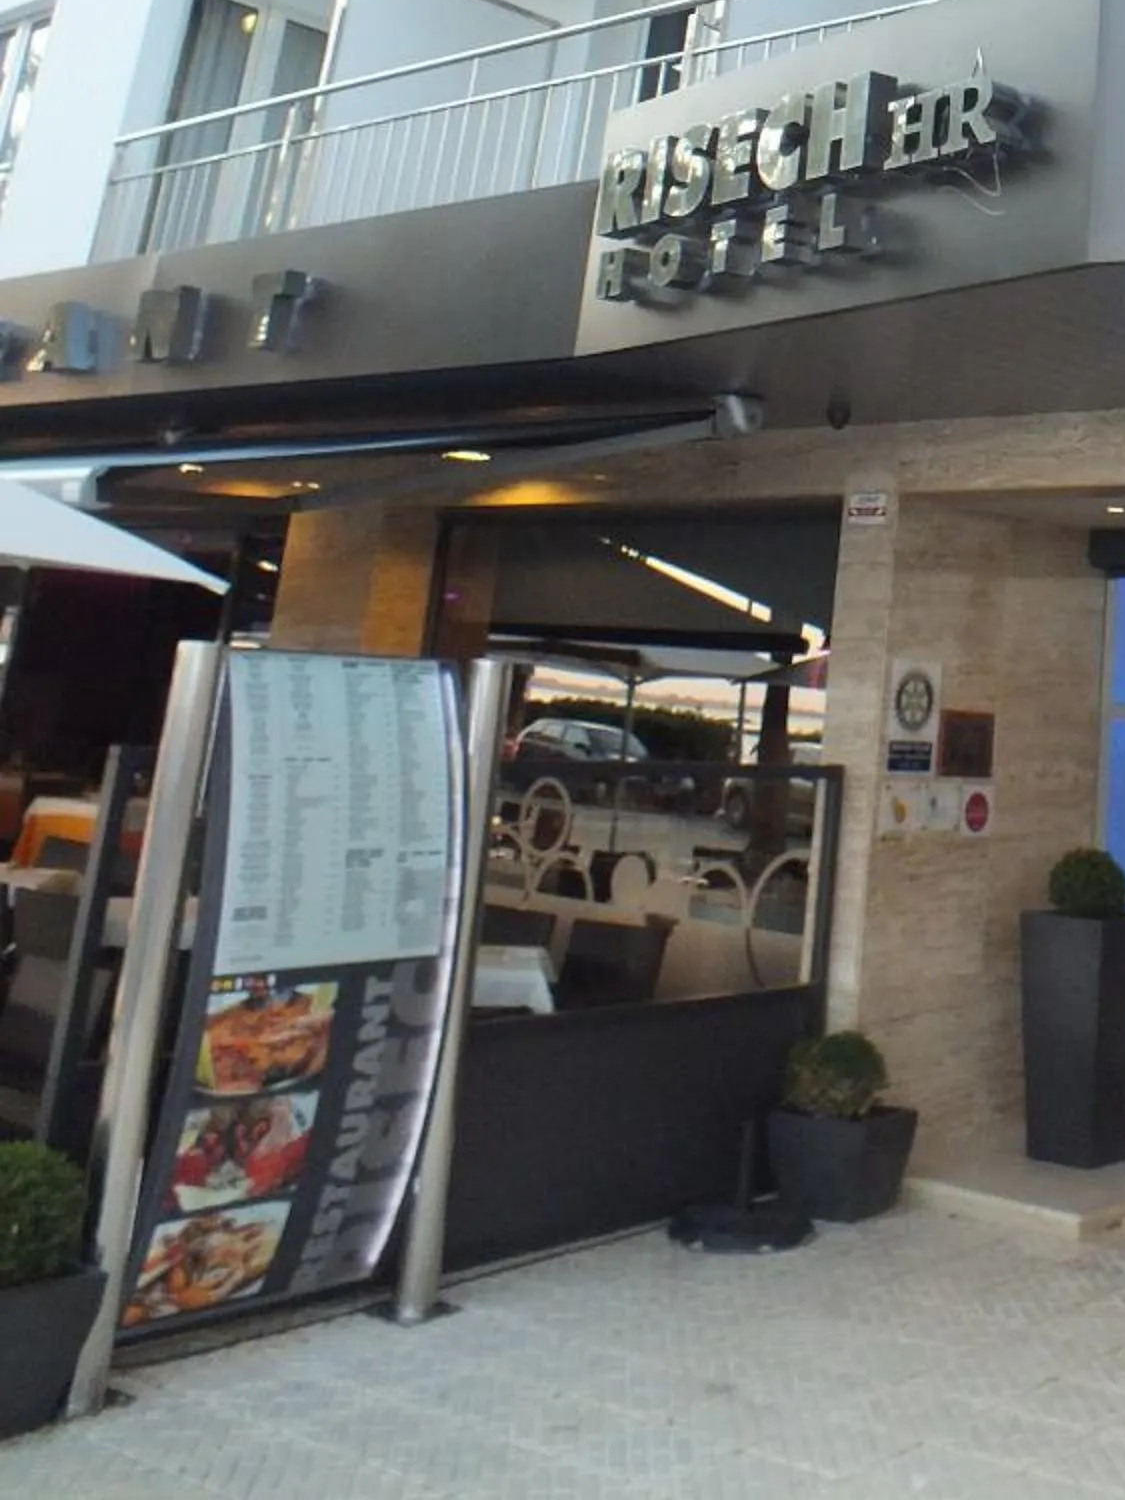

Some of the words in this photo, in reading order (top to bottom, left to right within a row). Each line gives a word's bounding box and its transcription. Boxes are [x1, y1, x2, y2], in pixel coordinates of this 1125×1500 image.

[598, 70, 876, 236] RISECH
[597, 192, 848, 301] HOTEL
[289, 974, 393, 1295] RESTAURANT
